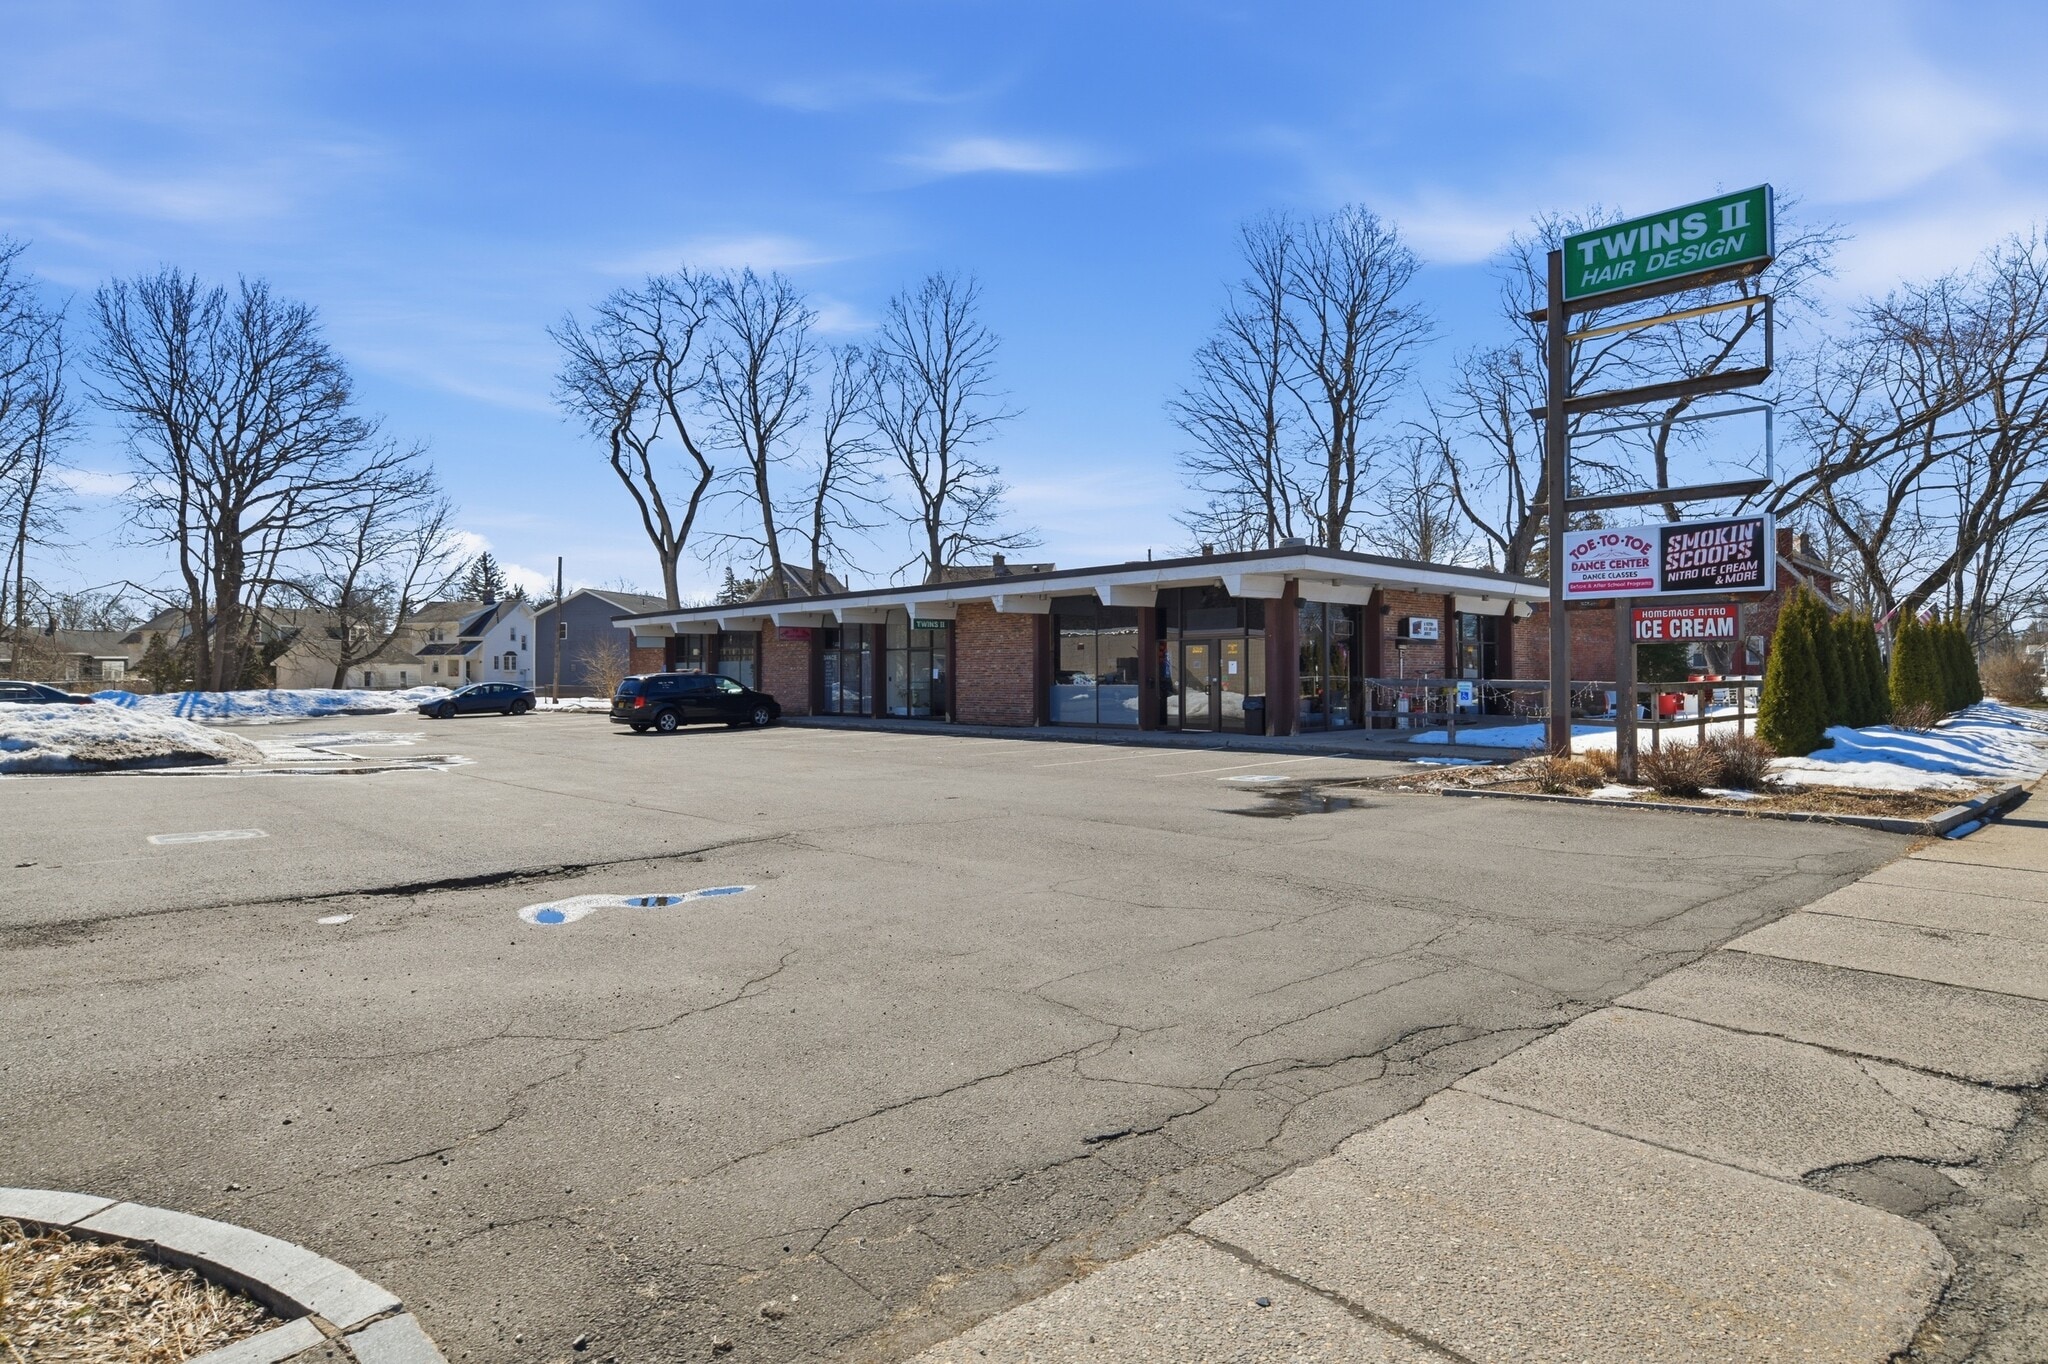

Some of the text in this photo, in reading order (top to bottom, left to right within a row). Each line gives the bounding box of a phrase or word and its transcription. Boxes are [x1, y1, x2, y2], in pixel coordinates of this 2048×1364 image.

[1577, 199, 1751, 266] TWINS II
[1580, 232, 1746, 288] HAIR DESIGN
[1667, 521, 1761, 553] SMOKIN'
[1571, 557, 1650, 572] DANCE CENTER
[1665, 540, 1753, 571] SCOOPS
[1582, 570, 1638, 580] DANCE CLASSES
[1667, 559, 1758, 582] NITRO ICE CREAM
[1626, 580, 1652, 588] Programs
[916, 620, 939, 628] TWINS
[1641, 608, 1695, 618] HOMEMADE
[1635, 617, 1734, 639] ICE CREAM
